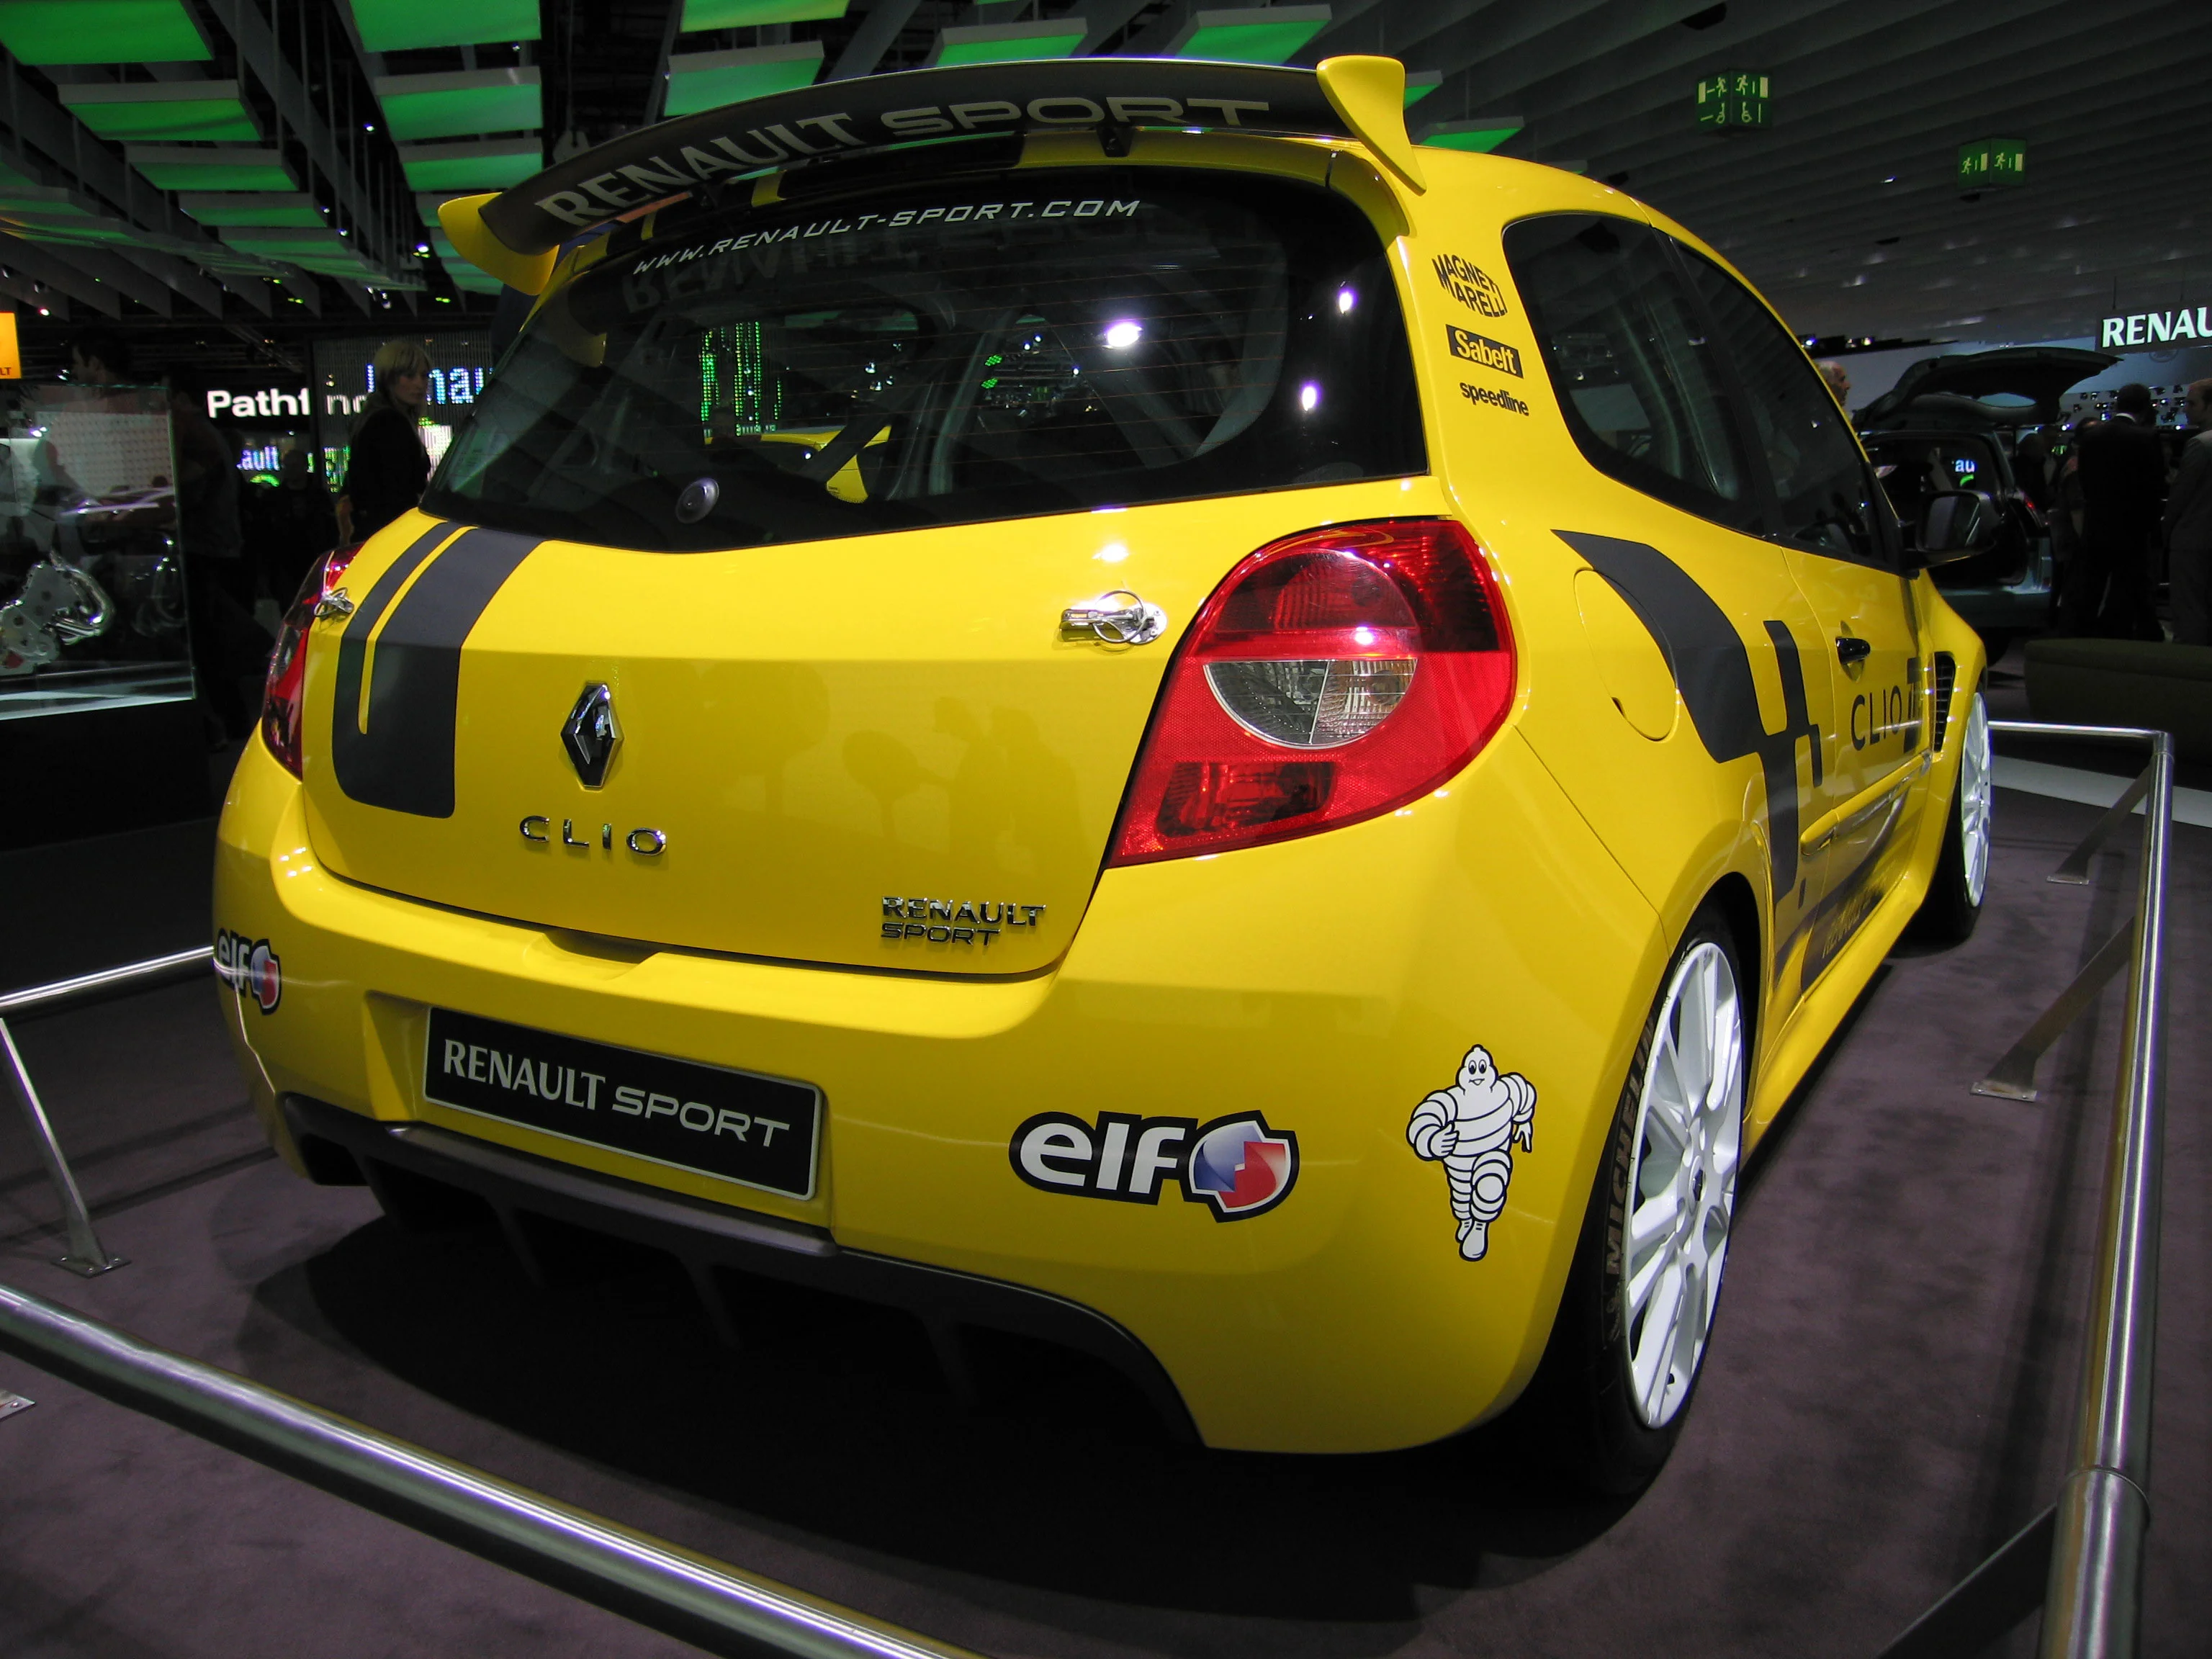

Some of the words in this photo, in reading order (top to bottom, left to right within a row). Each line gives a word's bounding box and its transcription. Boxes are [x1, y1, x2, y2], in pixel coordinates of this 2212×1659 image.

[534, 112, 863, 225] RENAULT
[881, 96, 1269, 137] SPORT
[633, 199, 1141, 275] WWW.RENAULT-SPORT.COM
[1454, 328, 1517, 375] Sabelt
[1459, 382, 1530, 416] speedline
[1851, 685, 1902, 751] CLIO
[518, 815, 667, 856] CLIO
[881, 896, 1047, 927] RENAULT
[881, 922, 1002, 947] SPORT
[443, 1038, 606, 1110] RENAULT
[612, 1085, 790, 1148] SPORT
[1020, 1121, 1185, 1194] elf
